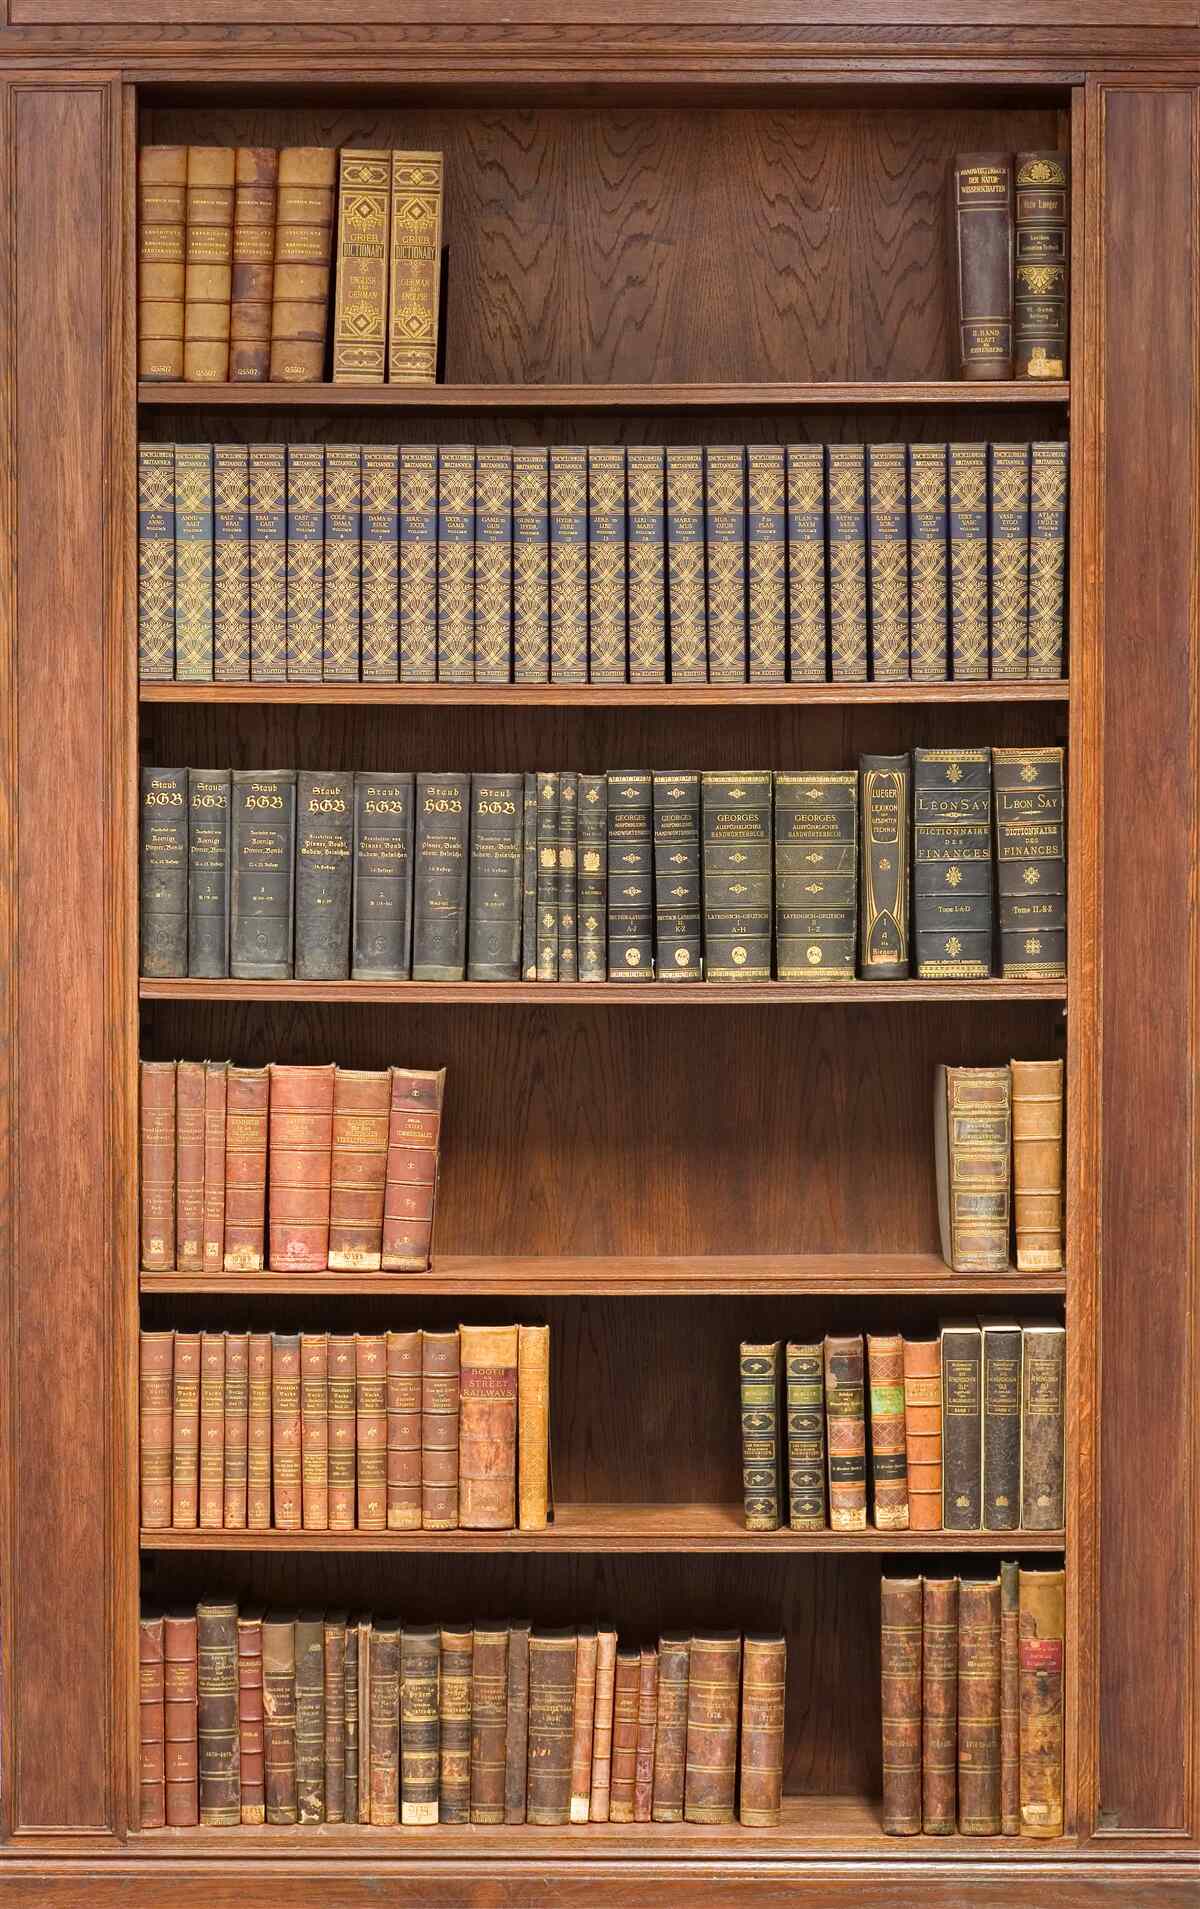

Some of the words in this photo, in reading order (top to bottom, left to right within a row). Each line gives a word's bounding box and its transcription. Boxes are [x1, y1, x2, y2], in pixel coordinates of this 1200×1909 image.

[344, 244, 384, 257] DICTIONARY
[396, 245, 435, 260] DICTIONARY
[151, 780, 177, 789] Staub
[197, 782, 224, 791] Staub
[251, 784, 278, 792] Staub
[312, 786, 341, 795] Staub
[367, 788, 400, 796] Staub
[427, 787, 459, 796] Staub
[480, 789, 511, 798] Staub
[872, 789, 897, 798] LUEGER
[145, 792, 183, 807] HGB
[192, 794, 228, 809] HGB
[244, 795, 284, 810] HGB
[1037, 794, 1057, 808] SAY
[307, 799, 345, 815] HGB
[364, 800, 402, 815] HGB
[423, 800, 462, 814] HGB
[479, 801, 516, 815] HGB
[872, 804, 898, 812] LEXIKON
[960, 799, 989, 810] SAY
[717, 814, 760, 822] GEORGES
[794, 814, 838, 822] GEORGES
[1007, 826, 1057, 836] DICTIONNAIRE
[918, 849, 989, 858] FINANCES
[1004, 846, 1058, 856] FINANCES
[1013, 905, 1030, 914] Tome
[472, 1368, 504, 1376] BOOTH
